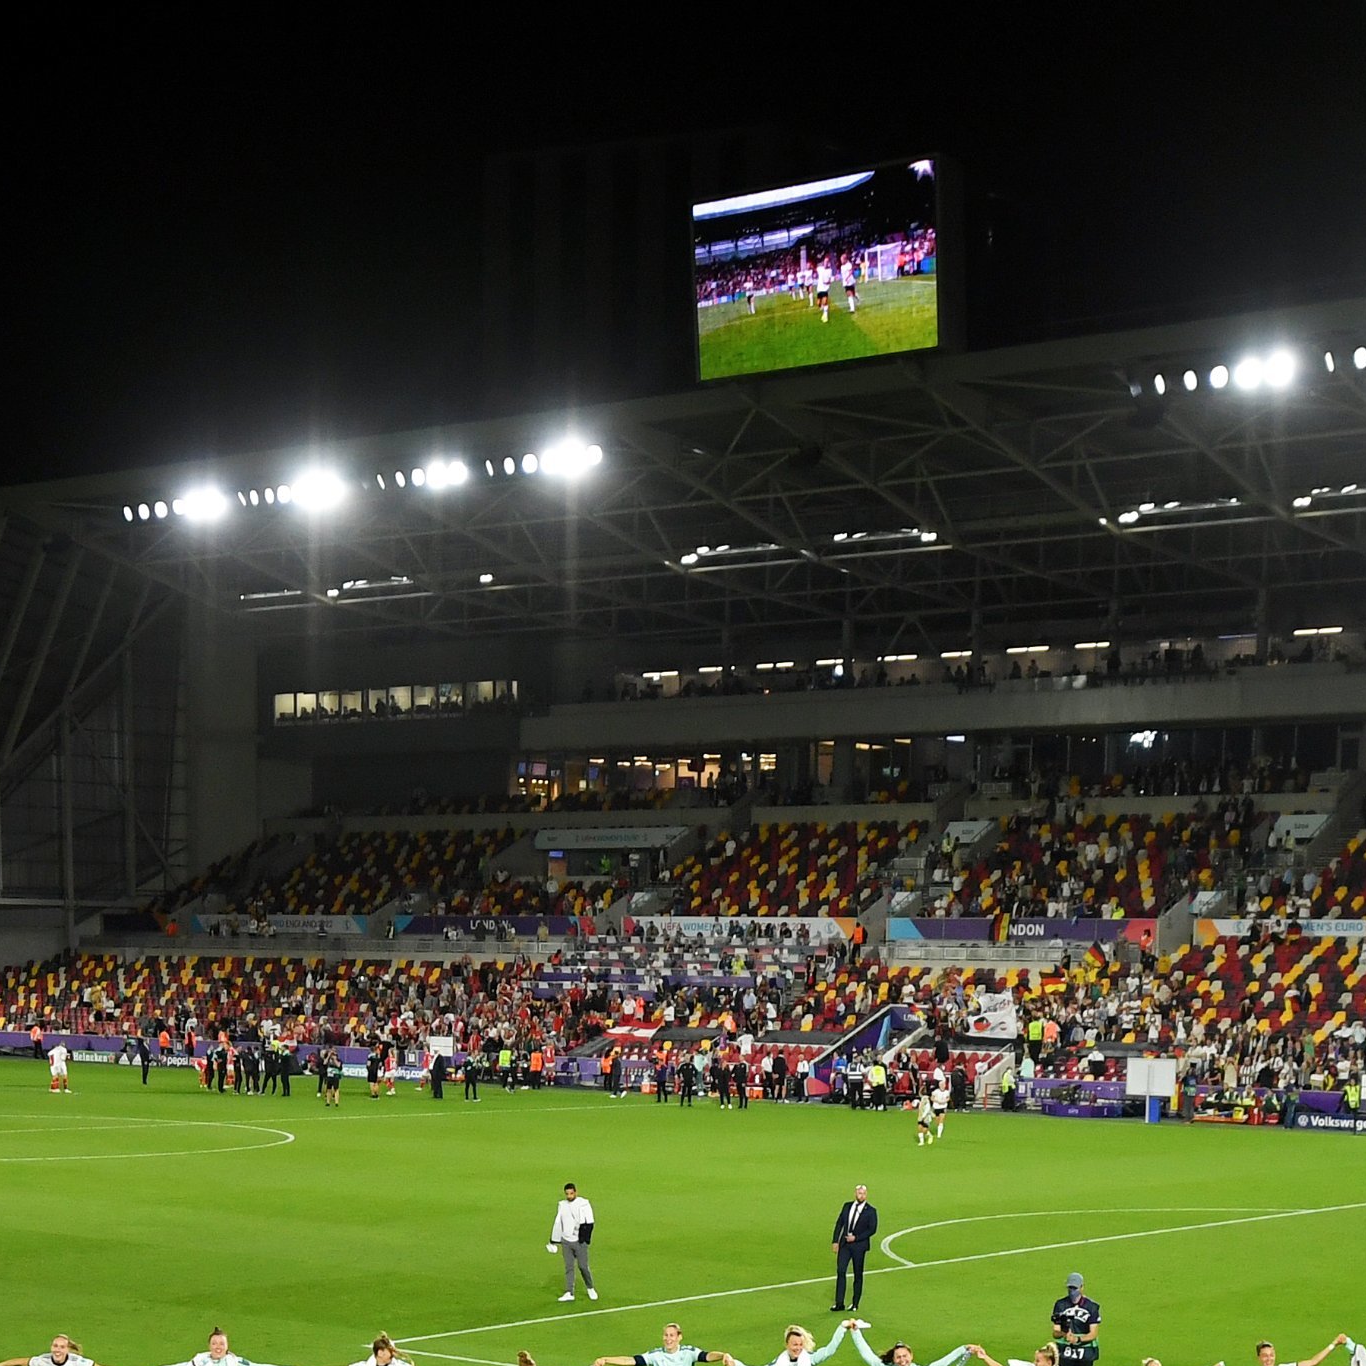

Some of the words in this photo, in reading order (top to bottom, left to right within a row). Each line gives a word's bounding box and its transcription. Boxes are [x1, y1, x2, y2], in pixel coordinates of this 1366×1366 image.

[1335, 922, 1363, 932] EURO
[73, 1052, 108, 1063] Heineken
[167, 1056, 189, 1067] pepsi
